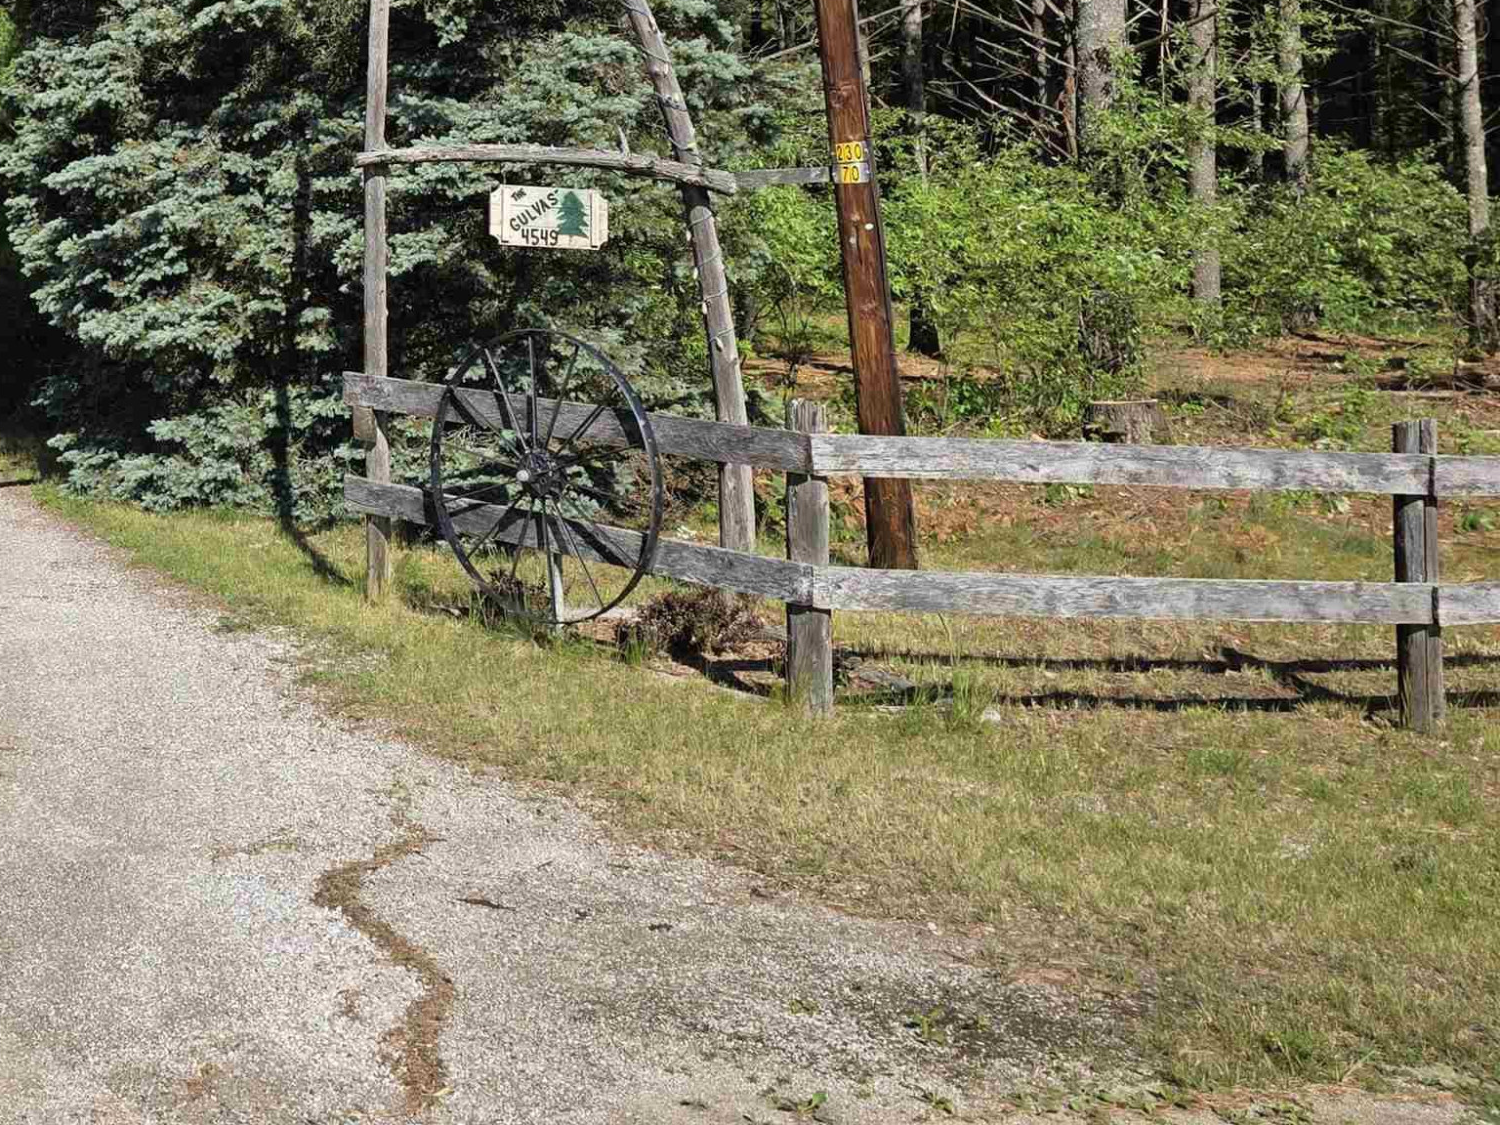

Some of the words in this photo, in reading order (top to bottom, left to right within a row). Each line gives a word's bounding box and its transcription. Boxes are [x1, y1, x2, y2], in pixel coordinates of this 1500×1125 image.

[836, 143, 862, 161] 230
[843, 166, 860, 181] 70
[521, 228, 559, 246] 4549
